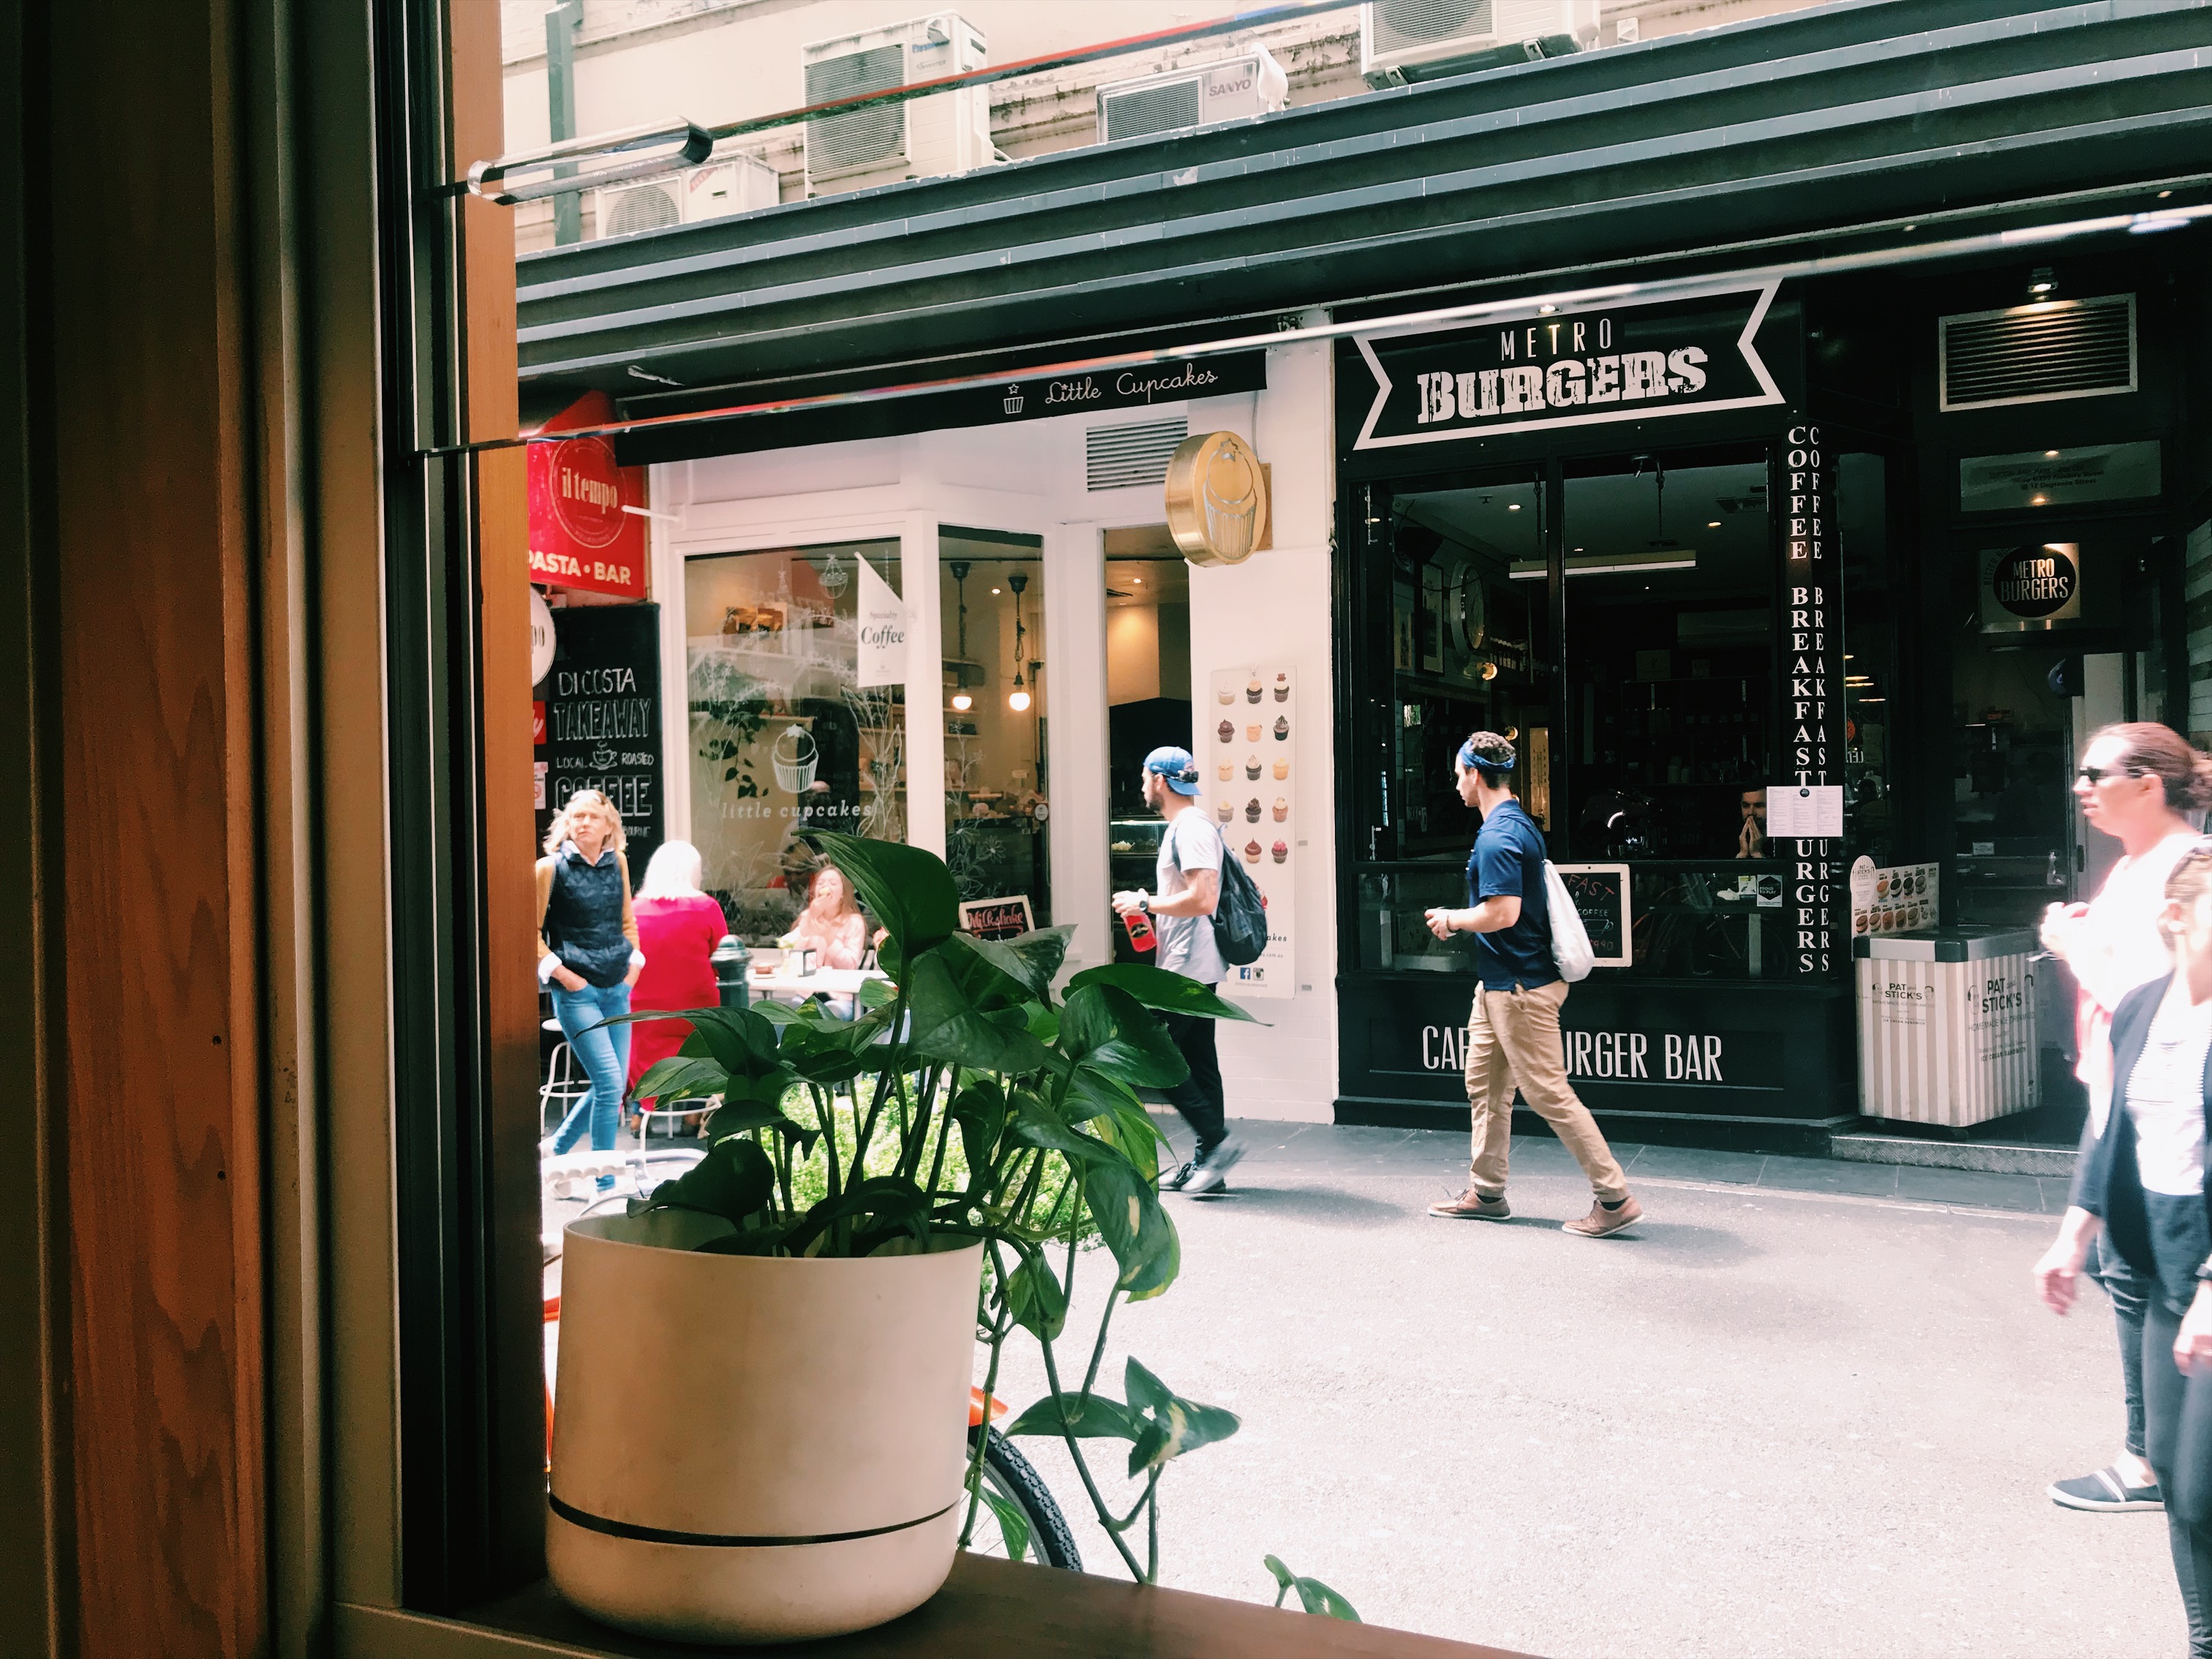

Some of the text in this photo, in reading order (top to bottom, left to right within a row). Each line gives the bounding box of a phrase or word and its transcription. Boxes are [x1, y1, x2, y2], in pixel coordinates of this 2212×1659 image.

[1208, 78, 1252, 97] SANYO
[1501, 318, 1611, 361] METRO
[1045, 363, 1219, 404] Little Cupcakes
[1417, 346, 1708, 424] BURGERS
[561, 467, 618, 514] il tempo
[593, 561, 632, 585] BAR
[2013, 558, 2055, 579] METRO
[2001, 576, 2069, 602] BURGERS
[861, 624, 905, 650] Coffee
[1788, 426, 1816, 974] COFFEE BREAKFAST URGERS
[1810, 426, 1830, 972] COFFEE BREAKFAST URGERS
[553, 697, 652, 741] TAKEAWAY
[556, 751, 655, 769] LOCAL ROASTED
[722, 799, 873, 821] little cupcakes
[1885, 990, 1922, 1000] STICK'S
[1889, 982, 1907, 990] PAT
[1987, 977, 2006, 995] PAT
[1982, 992, 2023, 1013] STICK'S
[1422, 1025, 1470, 1071] CAF
[1665, 1034, 1723, 1081] BAR
